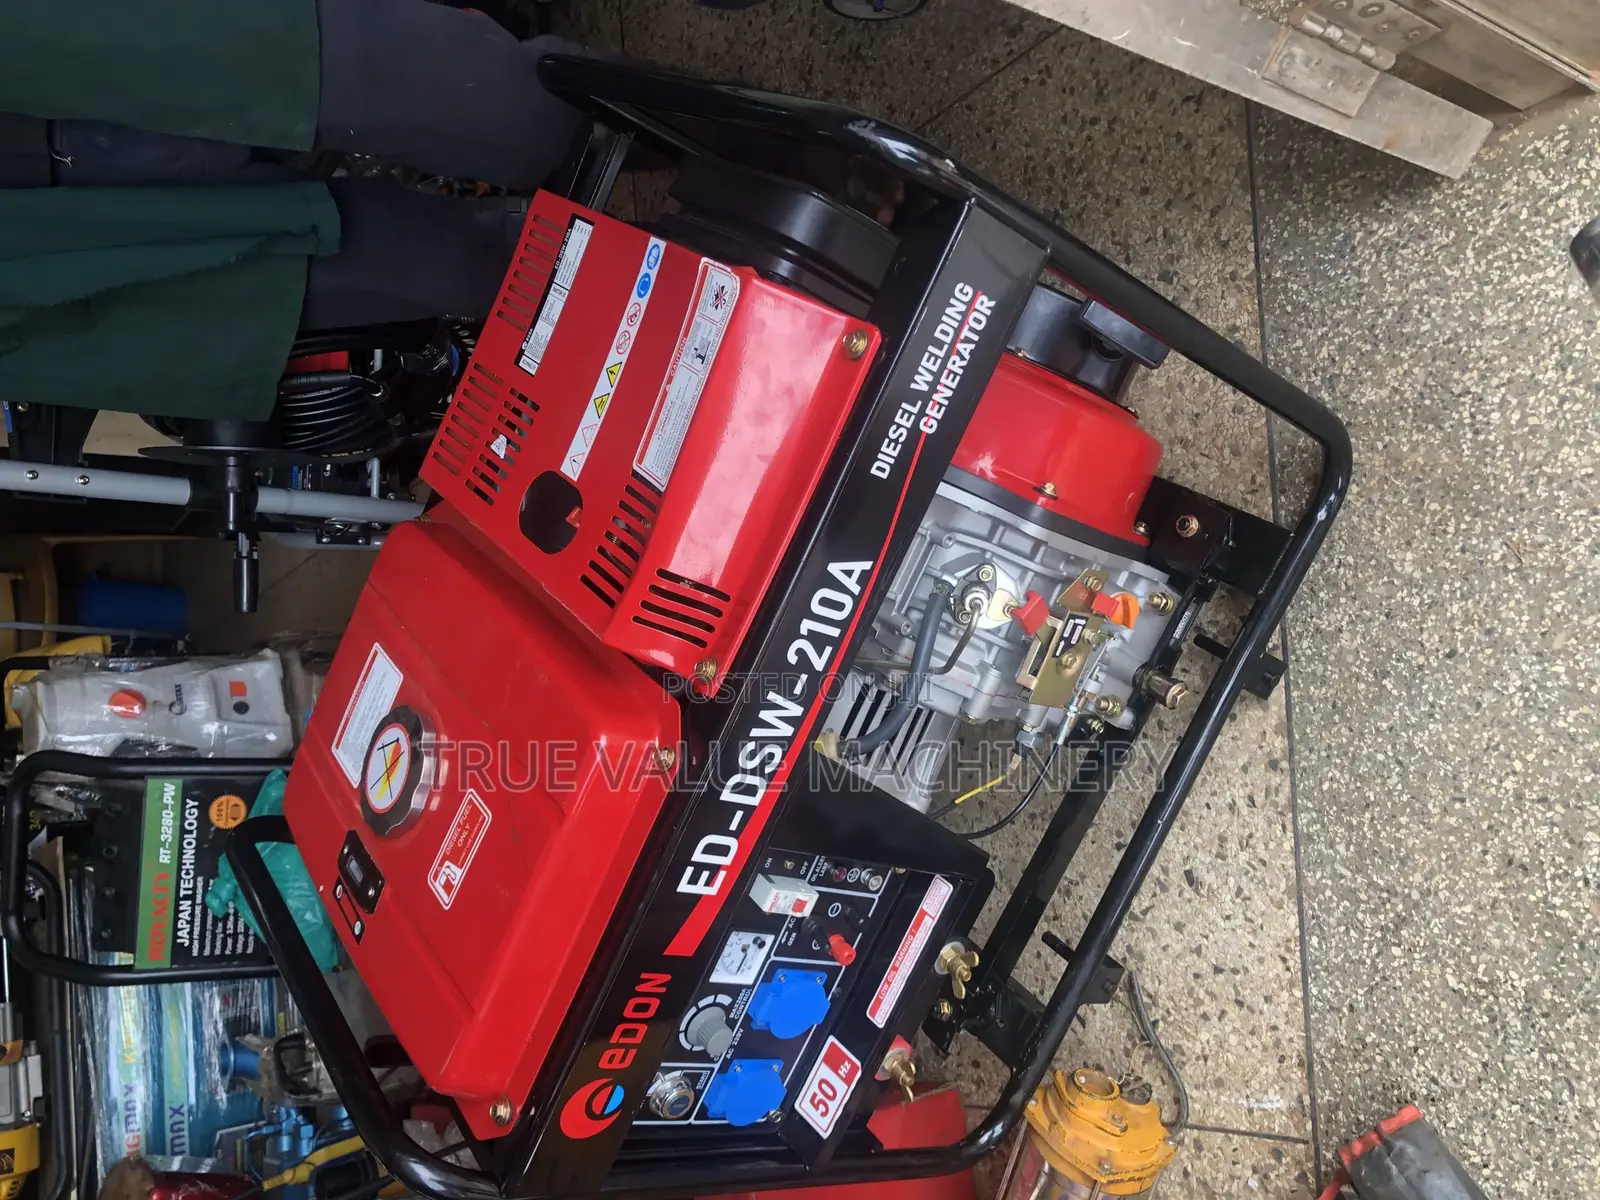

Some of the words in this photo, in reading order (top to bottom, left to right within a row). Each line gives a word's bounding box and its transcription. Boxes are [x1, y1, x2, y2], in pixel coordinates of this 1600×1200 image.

[870, 400, 922, 480] DIESEL
[910, 282, 974, 392] WELDING
[919, 294, 996, 434] GENERATOR
[677, 561, 873, 896] ED-DSW-210A
[180, 798, 199, 897] TECHNOLOGY
[446, 826, 462, 855] DIESEL
[460, 804, 472, 824] FUEL
[458, 824, 470, 846] ONLY
[148, 869, 170, 961] ROYALTY
[159, 782, 175, 864] RT-3280-PW
[765, 858, 772, 868] ON
[800, 861, 808, 874] OFF
[176, 900, 192, 947] JAPAN
[878, 986, 890, 1000] LOW
[888, 970, 897, 984] OIL
[894, 936, 914, 966] WARNING
[726, 1048, 734, 1060] AC
[732, 1028, 744, 1046] 220V
[838, 1060, 851, 1078] Hz
[809, 1078, 838, 1118] 50
